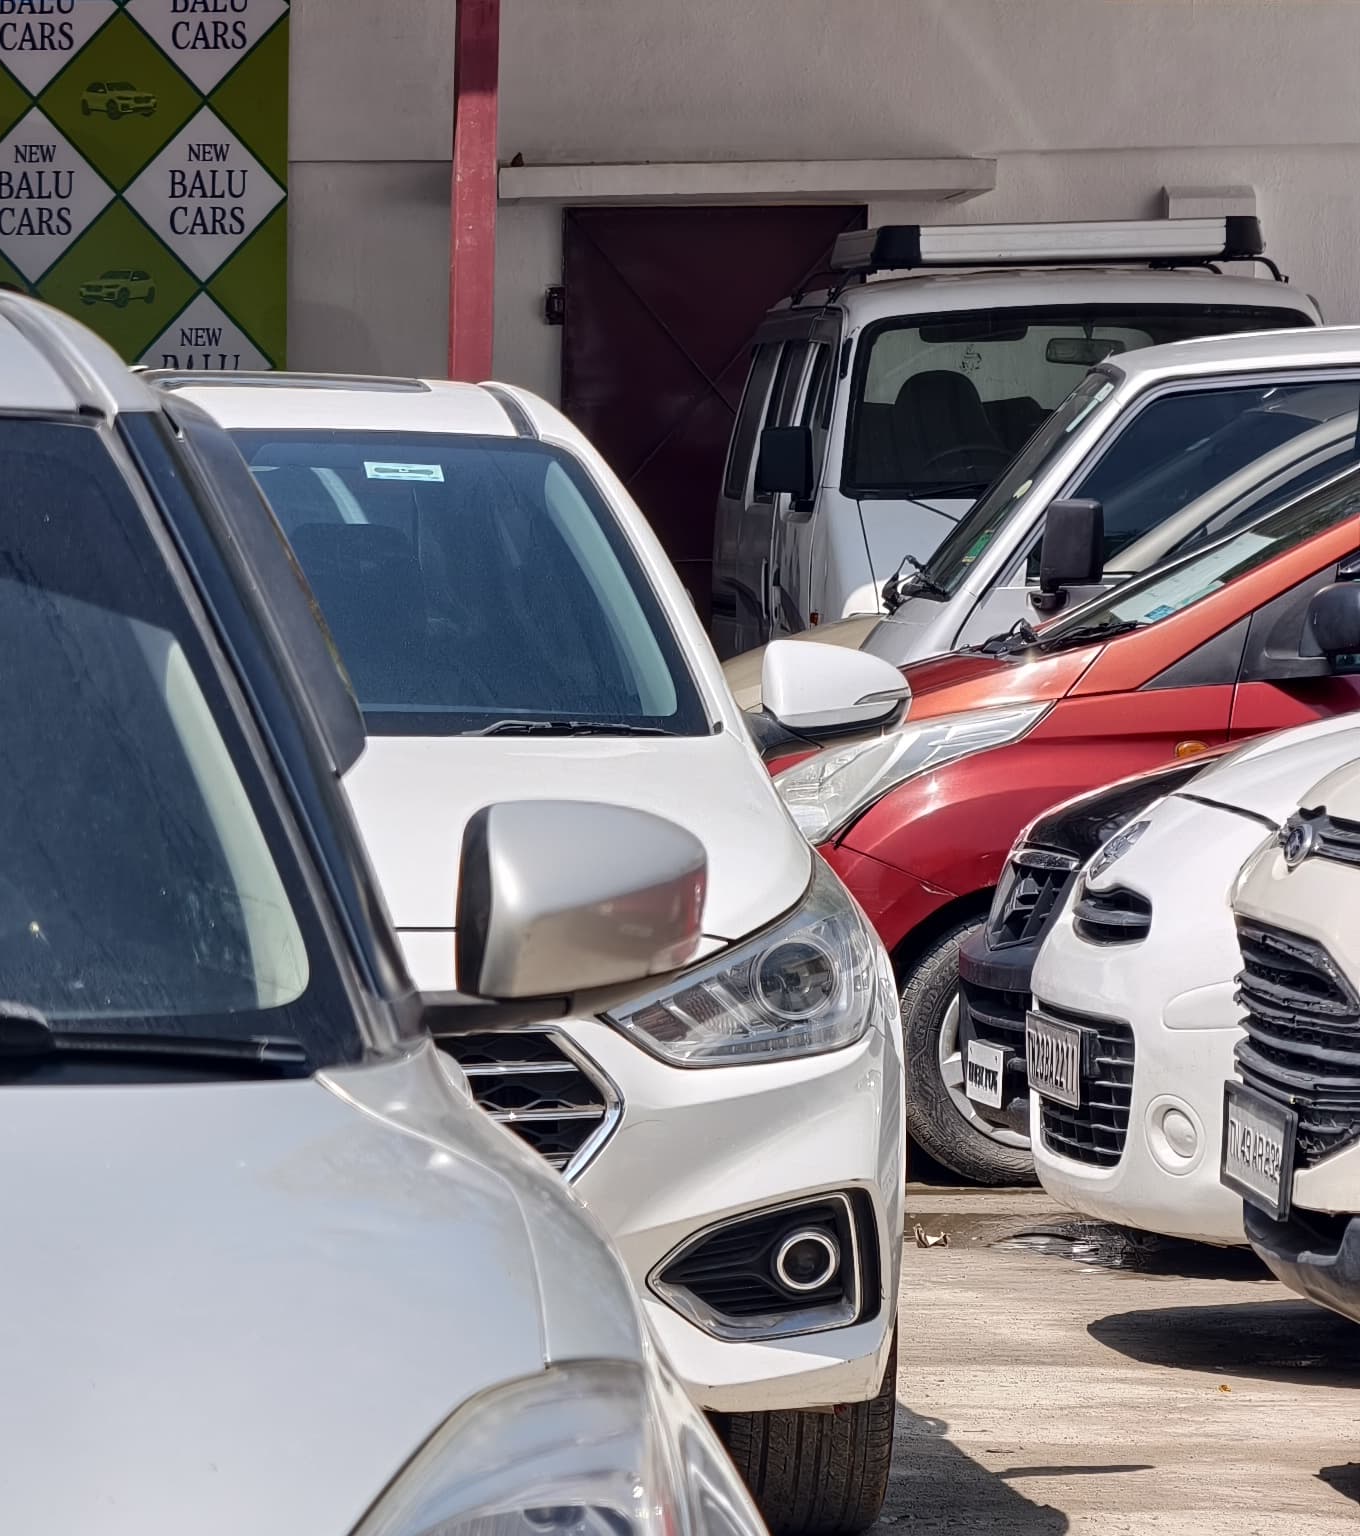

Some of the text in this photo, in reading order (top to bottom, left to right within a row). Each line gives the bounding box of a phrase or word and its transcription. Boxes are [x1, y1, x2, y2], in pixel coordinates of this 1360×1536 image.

[0, 22, 74, 50] CARS
[172, 21, 247, 49] CARS
[15, 144, 57, 163] NEW
[188, 143, 230, 162] NEW
[169, 170, 248, 198] BALU
[170, 206, 245, 235] CARS
[180, 328, 223, 347] NEW
